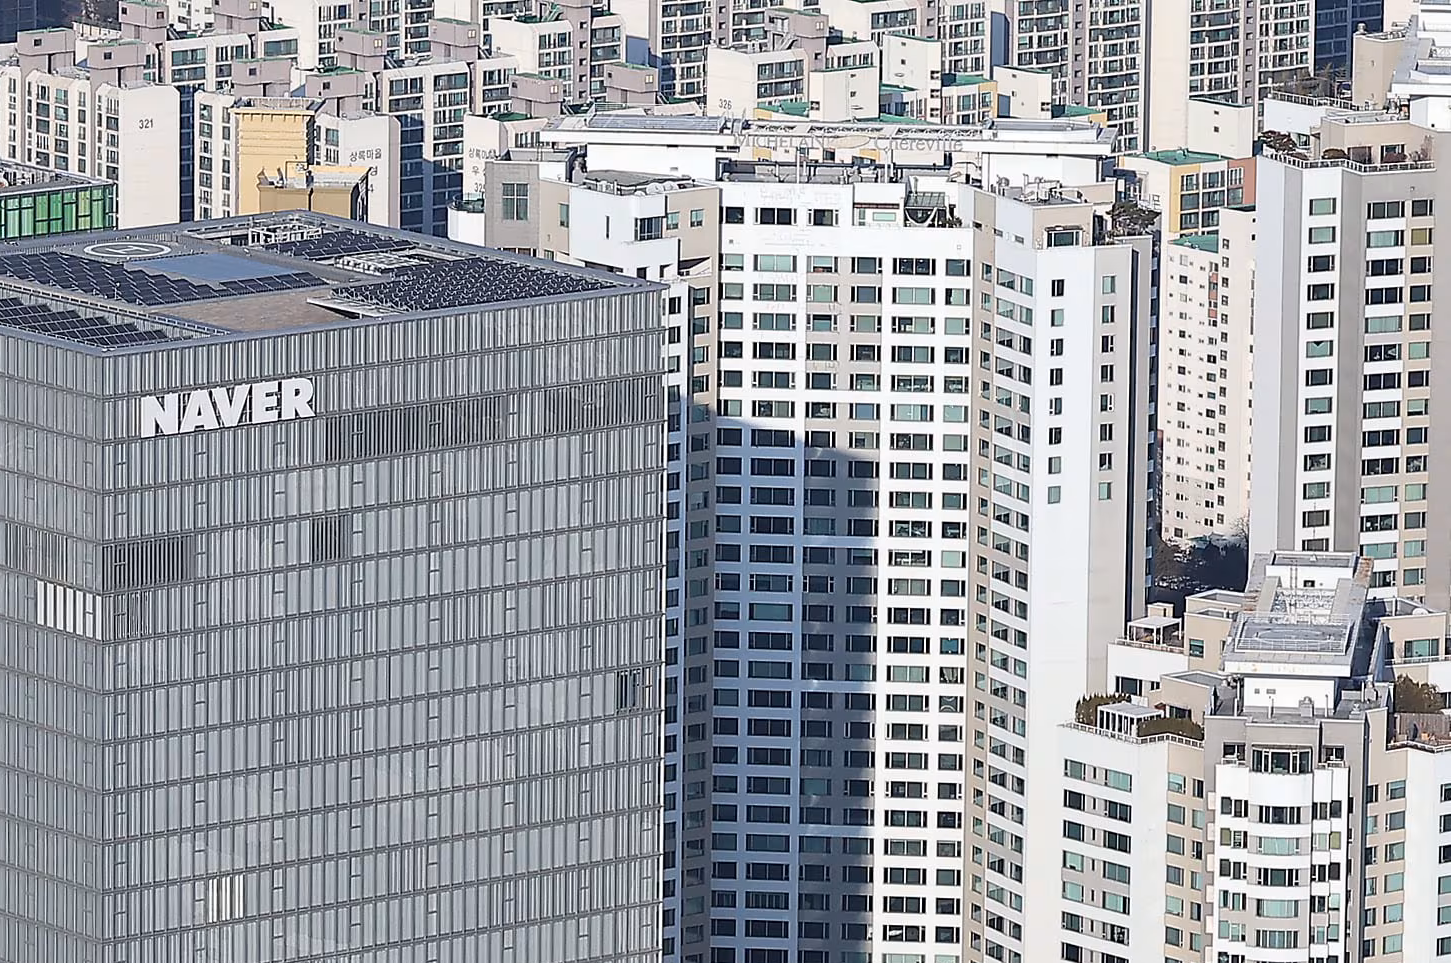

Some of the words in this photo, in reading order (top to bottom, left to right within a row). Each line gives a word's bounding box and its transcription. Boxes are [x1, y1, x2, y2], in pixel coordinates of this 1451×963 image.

[719, 98, 732, 110] 326
[139, 118, 154, 130] 321
[349, 148, 382, 162] 상록마을
[141, 377, 315, 438] NAVER
